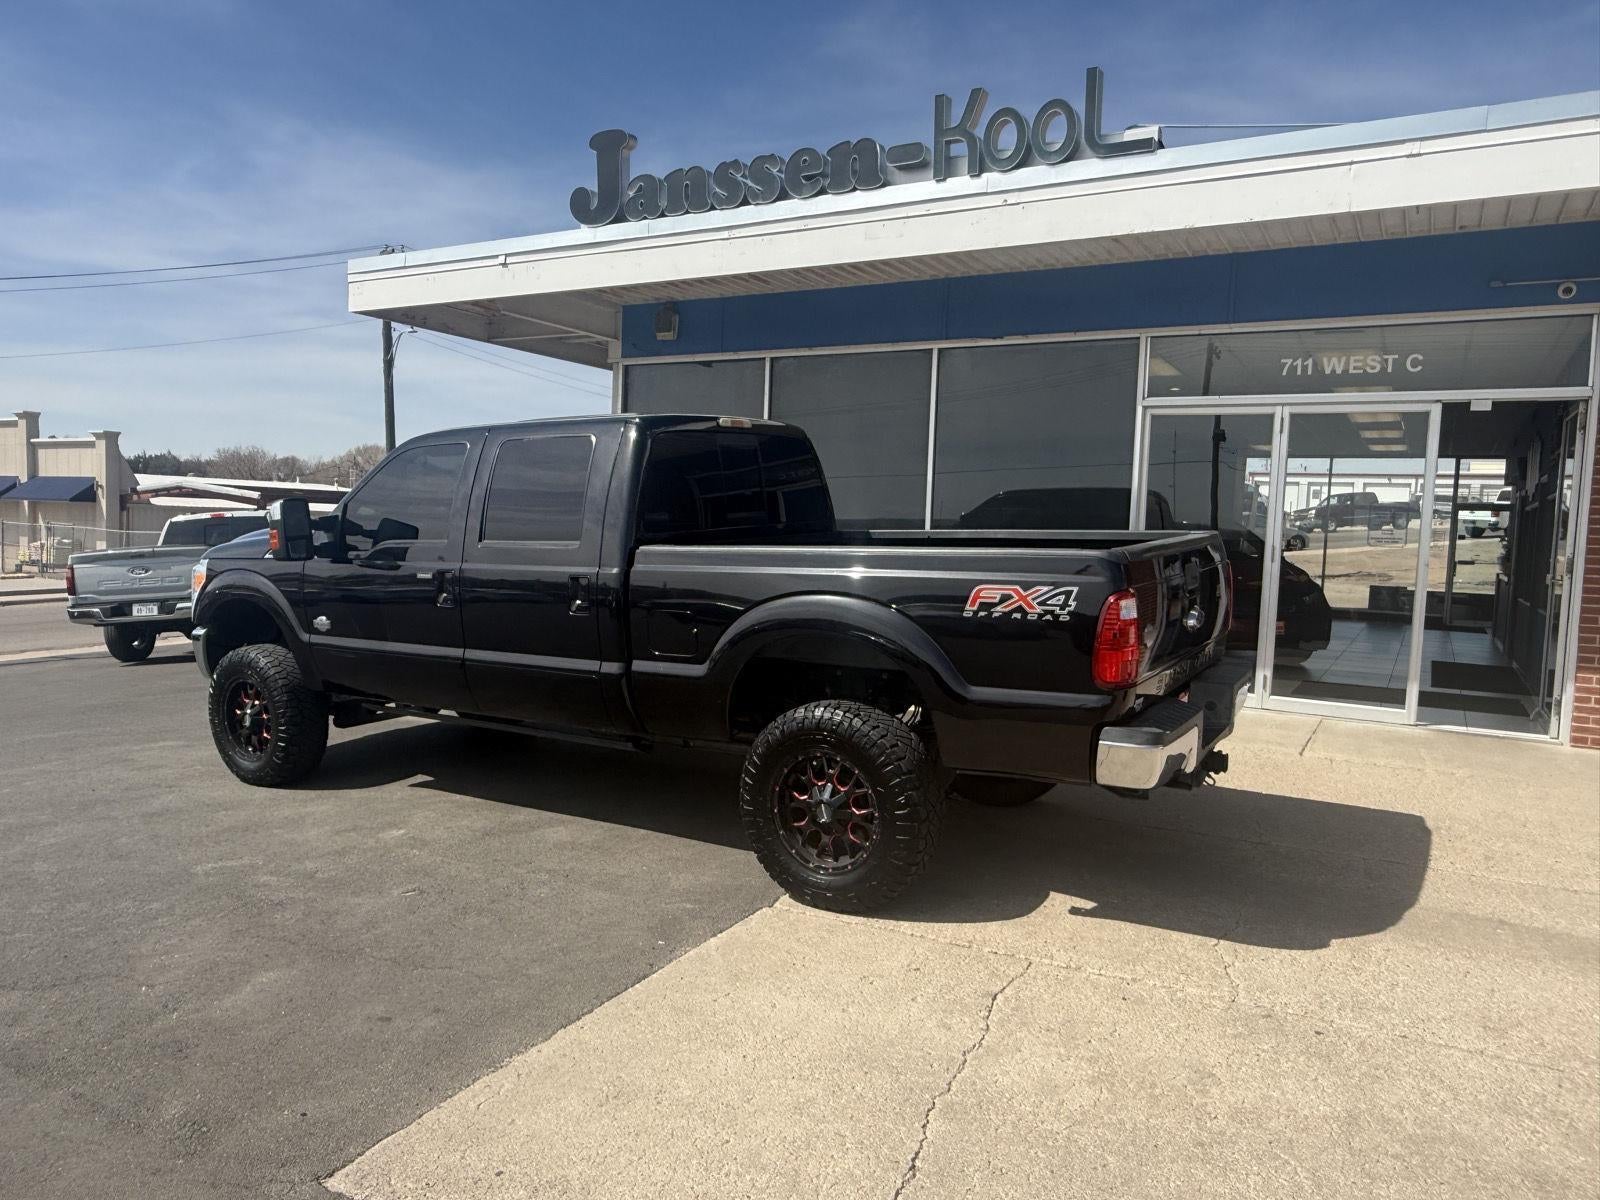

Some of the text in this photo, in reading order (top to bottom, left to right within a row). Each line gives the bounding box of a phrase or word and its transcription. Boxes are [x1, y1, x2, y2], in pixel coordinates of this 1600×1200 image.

[1280, 353, 1424, 375] 711 WEST C
[964, 584, 1079, 614] FX4
[1011, 613, 1070, 621] ROAD
